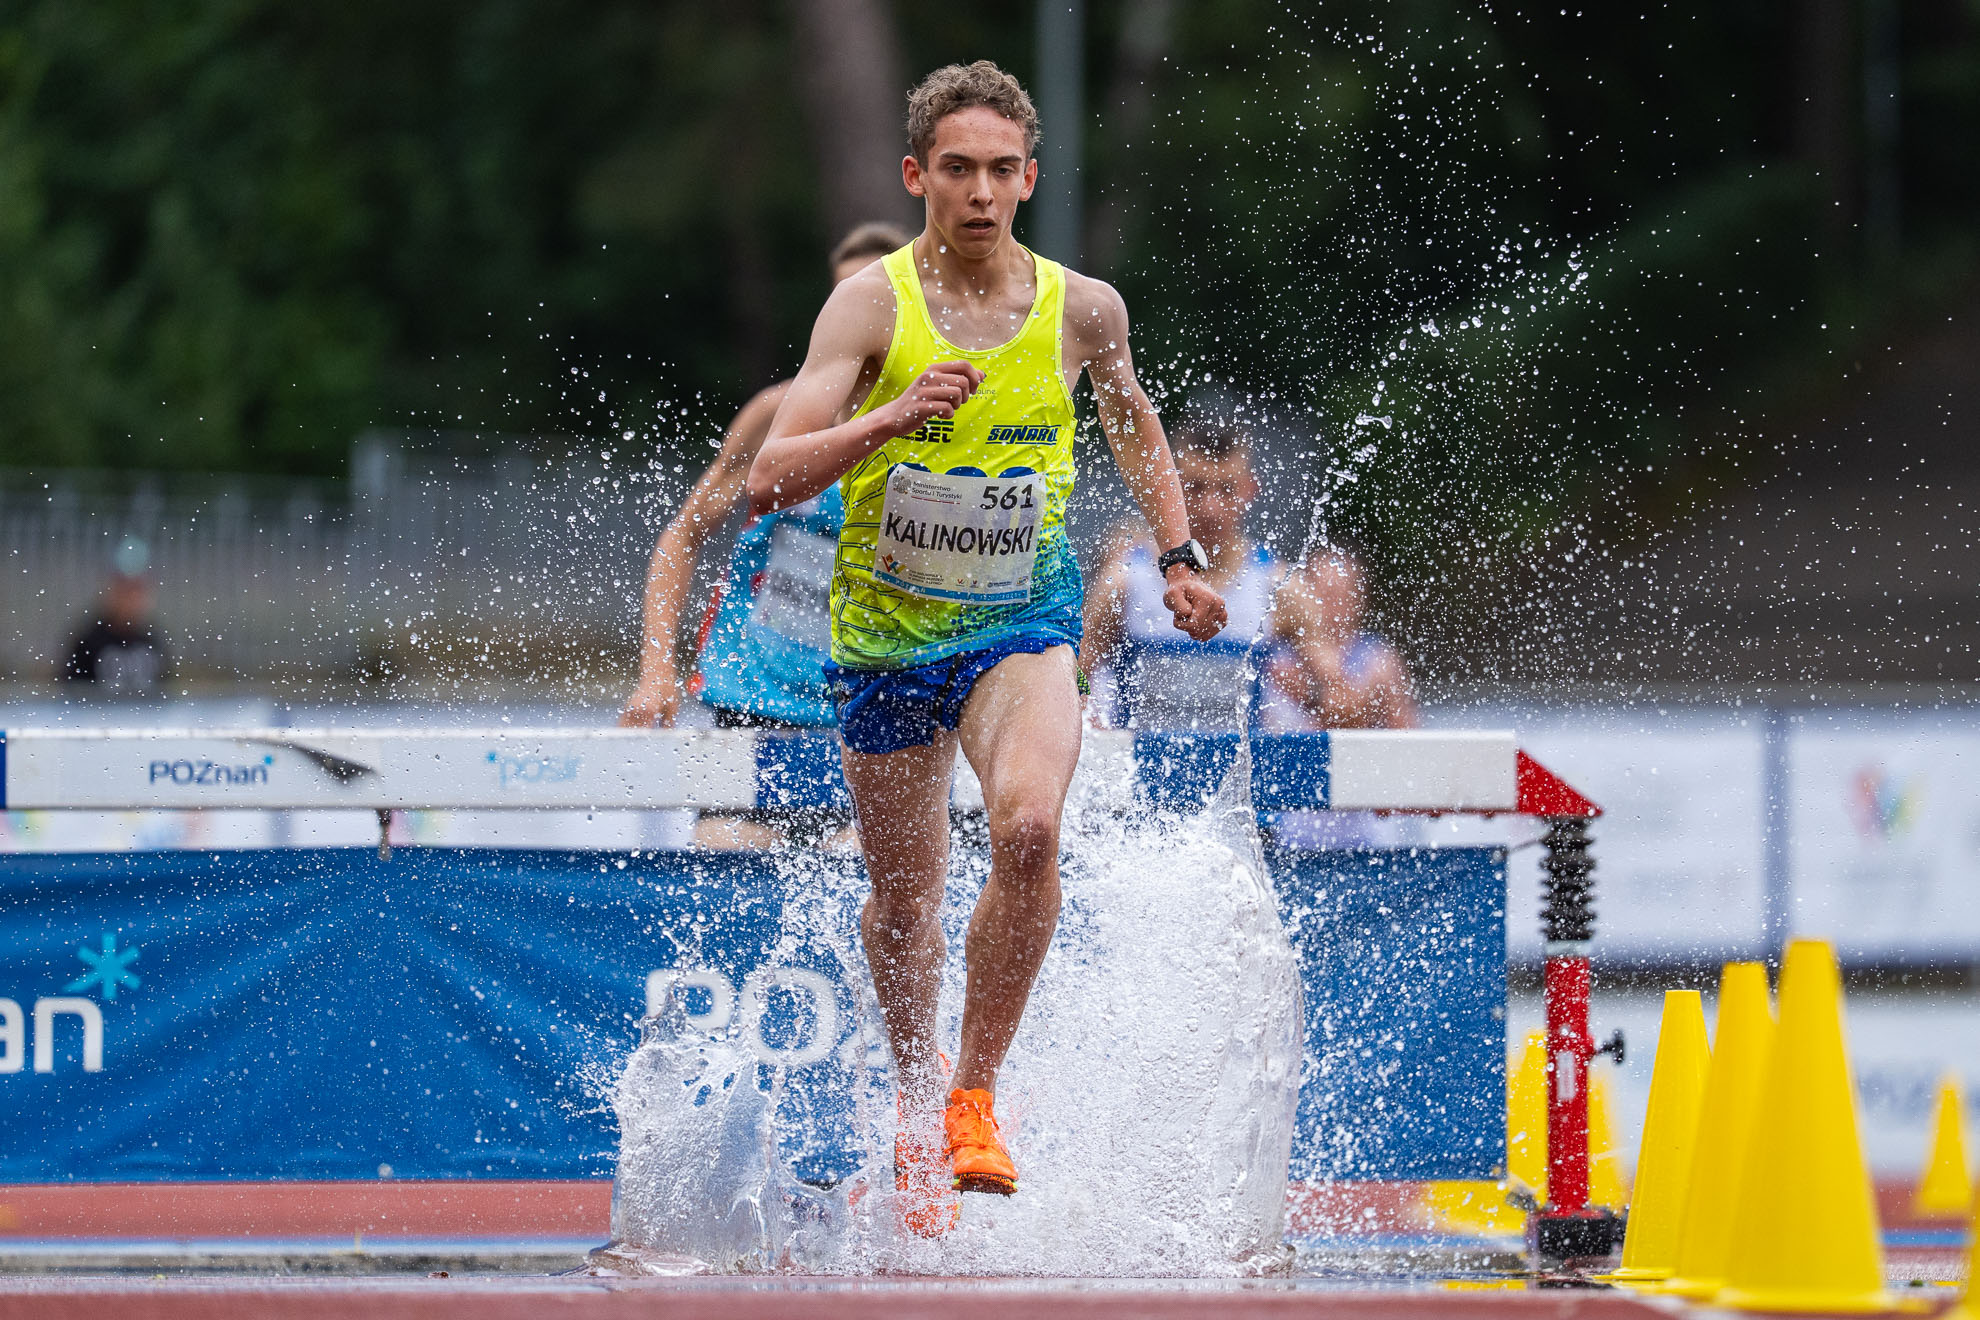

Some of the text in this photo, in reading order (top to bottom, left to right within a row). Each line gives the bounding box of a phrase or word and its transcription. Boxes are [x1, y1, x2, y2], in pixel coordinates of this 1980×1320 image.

[911, 488, 932, 496] Sportu
[913, 481, 951, 492] Ministerstwo
[980, 484, 1034, 510] 561
[884, 512, 1034, 556] KALINOWSKI
